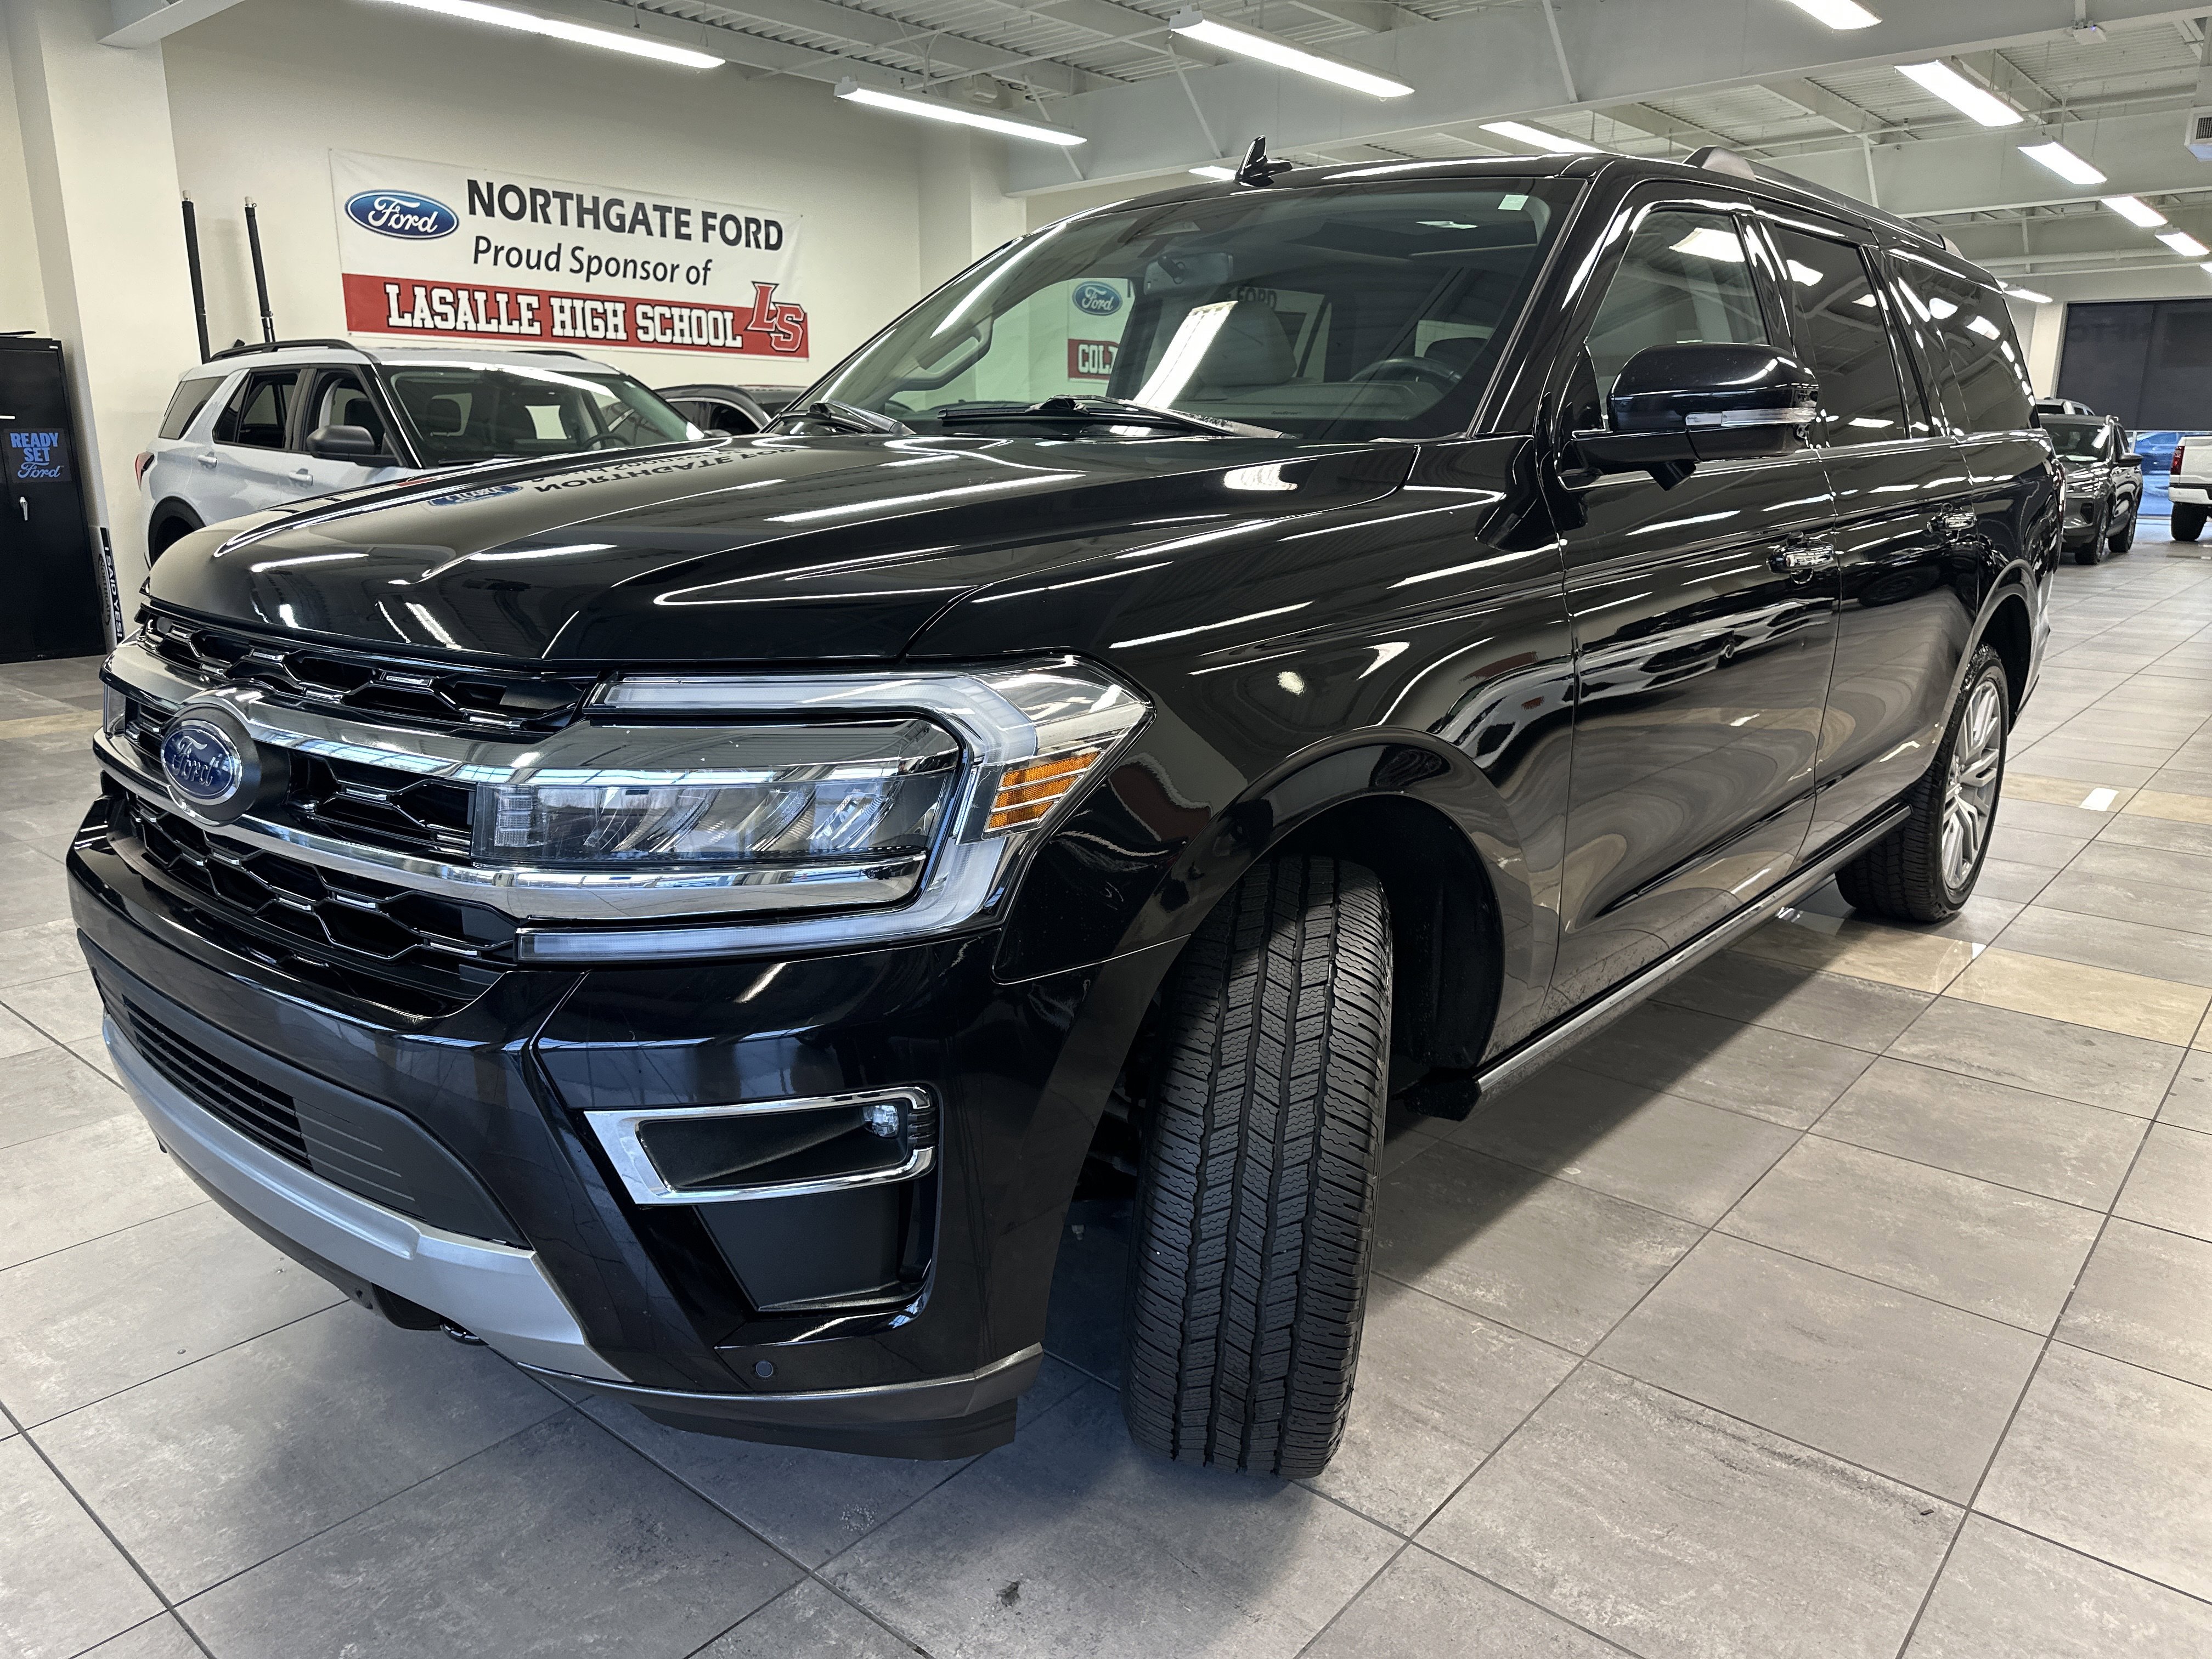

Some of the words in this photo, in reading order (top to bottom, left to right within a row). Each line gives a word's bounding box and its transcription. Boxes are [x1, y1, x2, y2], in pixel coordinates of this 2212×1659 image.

[368, 196, 438, 233] Ford
[467, 179, 692, 241] NORTHGATE
[702, 211, 783, 251] FORD
[473, 236, 562, 272] Proud
[569, 246, 680, 283] Sponsor
[686, 259, 713, 286] of
[385, 283, 543, 336] LASALLE
[549, 296, 629, 341] HIGH
[635, 303, 743, 349] SCHOOL
[744, 281, 805, 352] LS
[1081, 286, 1114, 311] Ford
[10, 432, 59, 448] READY
[24, 447, 50, 462] SET
[18, 461, 61, 478] Ford
[106, 555, 117, 595] SAID
[171, 735, 216, 787] Ford
